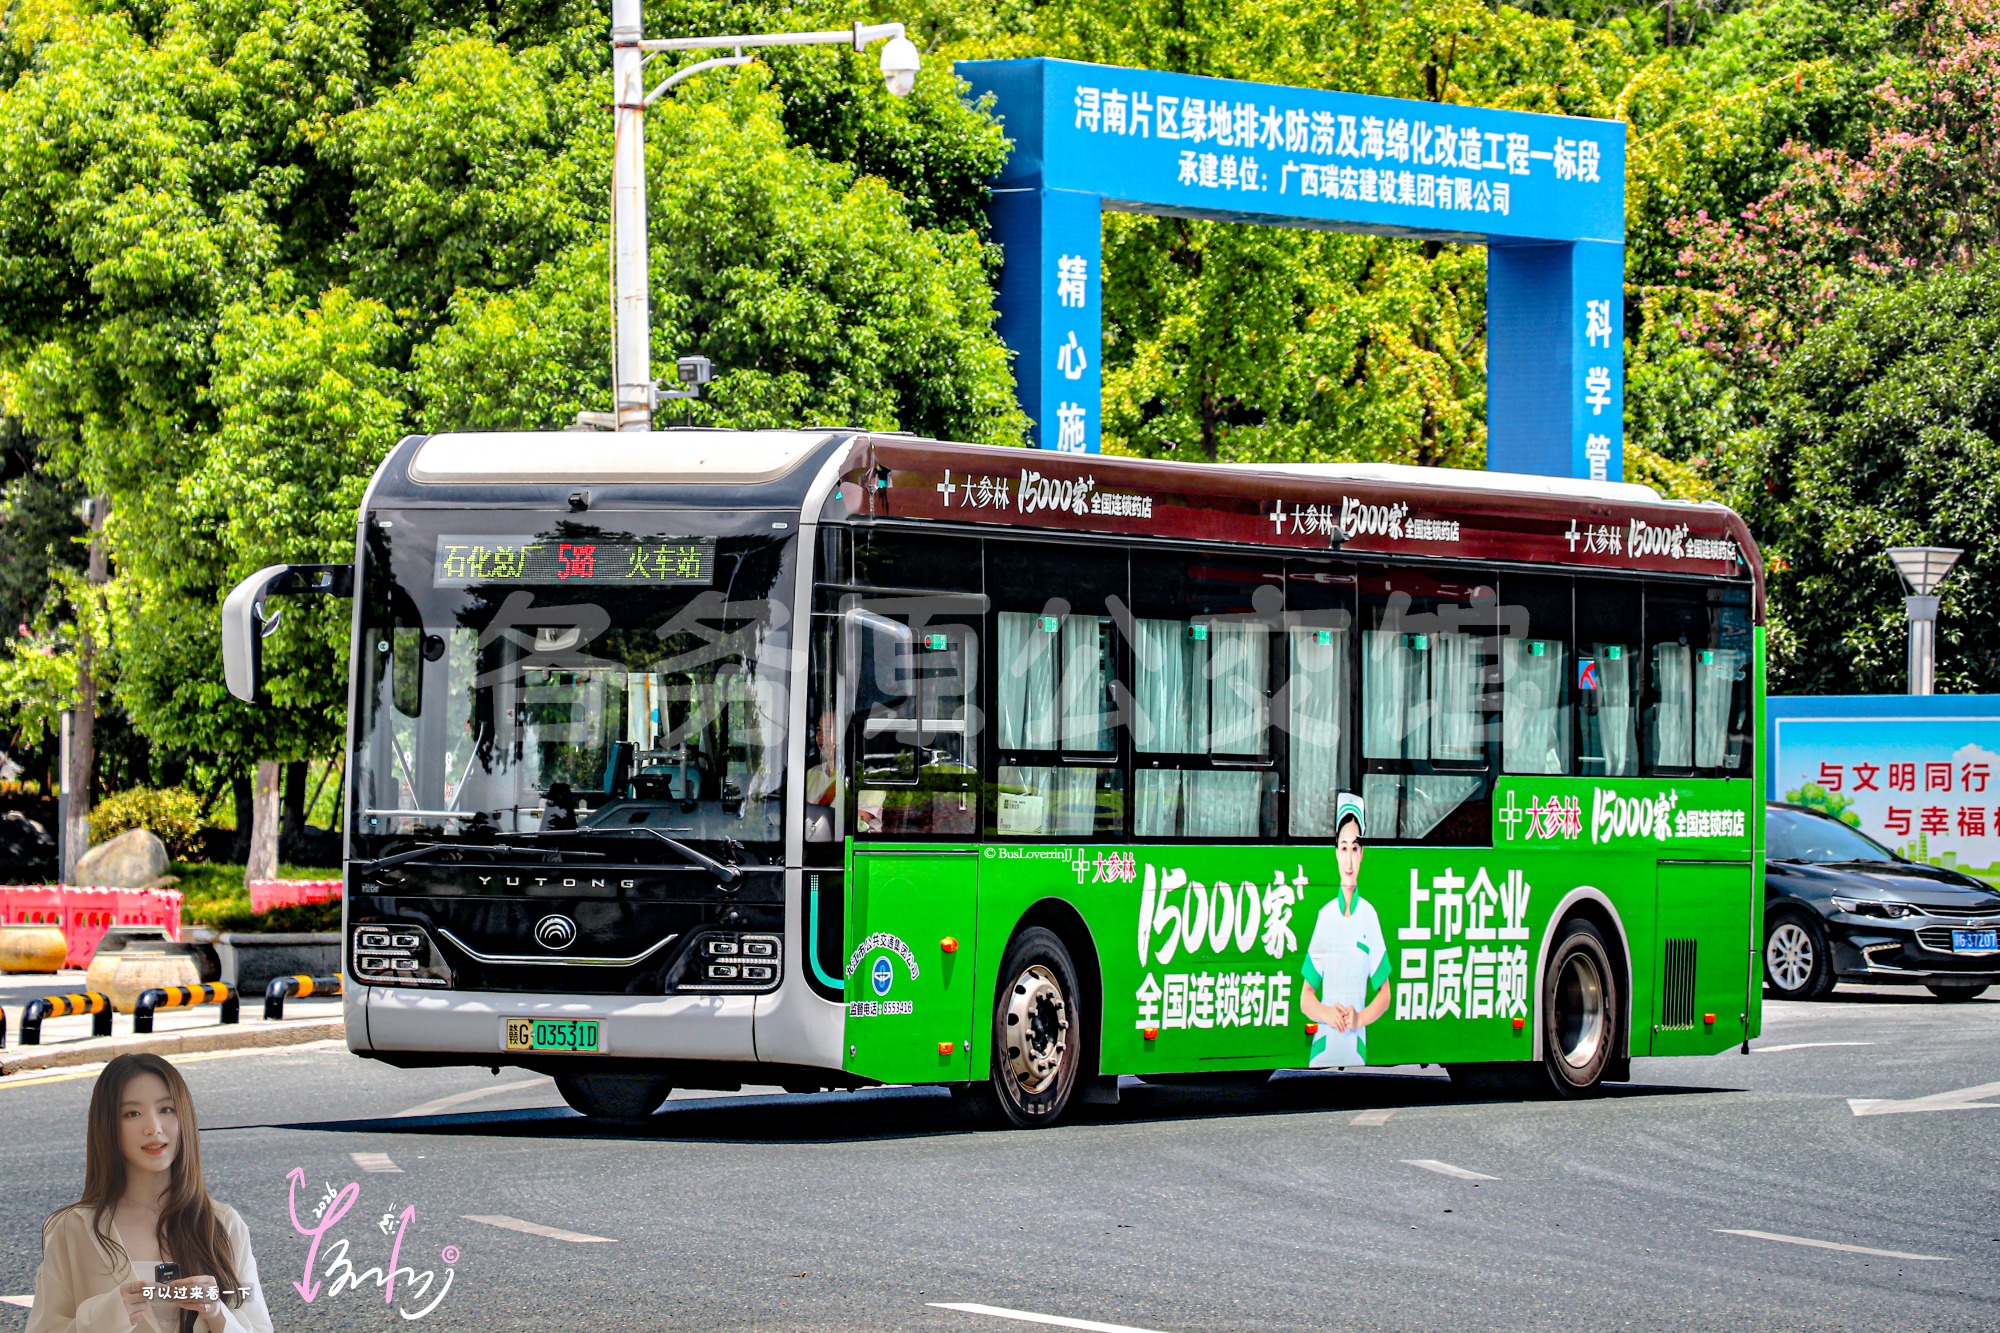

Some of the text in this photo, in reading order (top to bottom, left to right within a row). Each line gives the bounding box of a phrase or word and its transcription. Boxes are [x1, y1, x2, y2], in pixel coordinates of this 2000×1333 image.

[1074, 85, 1601, 183] 浔南片区绿地排水防涝及海绵化改造工程一标段
[1279, 159, 1511, 216] 广西瑞宏建设集团有限公司
[1057, 254, 1087, 452] 精心施
[961, 475, 1009, 510] 大参林
[1091, 493, 1152, 518] 全国连锁药店
[1290, 503, 1334, 536] 大参林
[1405, 518, 1460, 542] 全国连锁药店
[1584, 524, 1622, 554] 大参林
[443, 543, 701, 580] 石化总厂 5路 火车站
[1817, 762, 1990, 792] 与文明同行
[1525, 796, 1582, 840] 大参林
[1674, 809, 1745, 838] 全国连锁药店
[478, 875, 635, 889] YUTONG
[1091, 851, 1137, 884] 大参林
[1398, 866, 1531, 942] 上市企业
[1135, 972, 1291, 1029] 全国连锁药店
[1395, 945, 1528, 1020] 品质信赖
